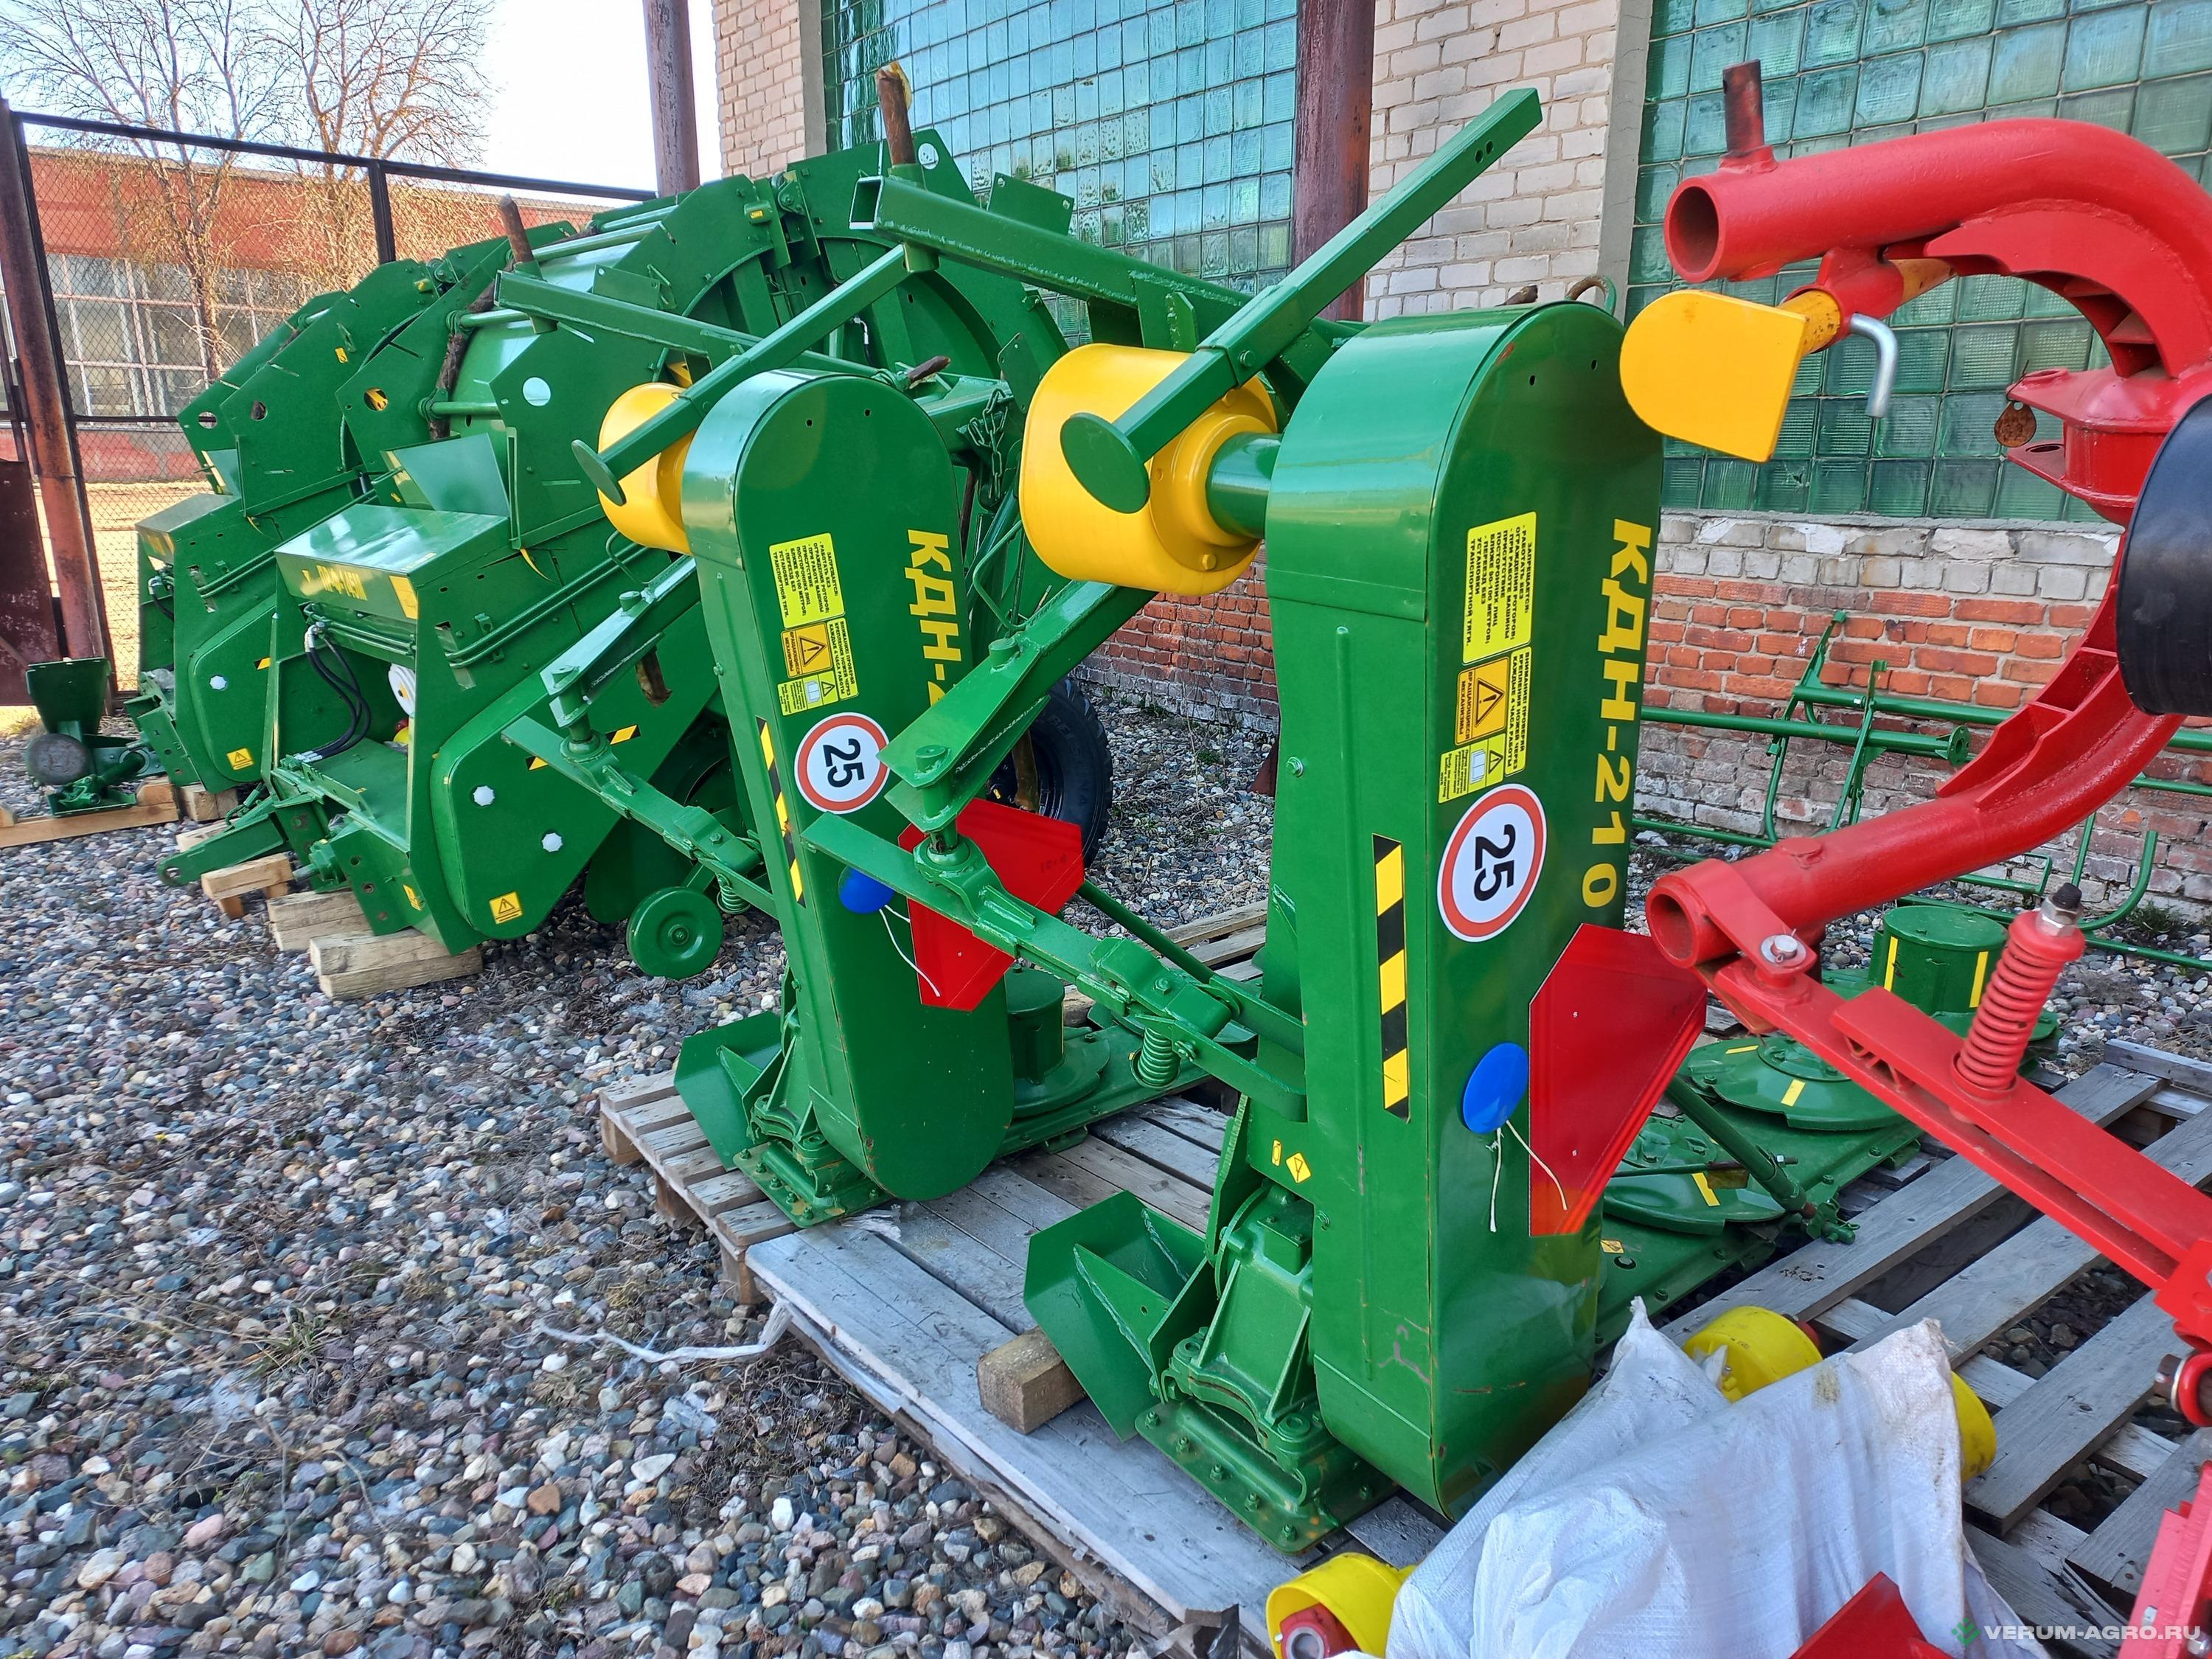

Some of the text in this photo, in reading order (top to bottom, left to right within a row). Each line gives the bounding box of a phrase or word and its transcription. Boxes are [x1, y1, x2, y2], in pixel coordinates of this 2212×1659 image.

[773, 552, 785, 599] ТРАНСПОРТНОЙ
[779, 551, 789, 586] УСТАНОВКИ
[785, 552, 793, 580] ПЕРЕЕЗД
[796, 547, 807, 591] ПОСТОРОННИХ
[802, 546, 813, 588] ПРИСУТСТВИЕ
[814, 543, 824, 583] ОГРАЖДЕНИЯ
[820, 545, 828, 575] РАБОТАТЬ
[827, 552, 838, 596] ЗАПРЕЩАЕТСЯ:
[1467, 538, 1475, 616] ТРАНСПОРТНОЙ
[810, 561, 818, 584] РАБОТЕ
[815, 585, 824, 613] МАШИНЫ
[785, 637, 793, 672] МЕХАНИЗМЫ
[790, 632, 800, 675] ВРАЩАЮЩИЕСЯ
[830, 624, 838, 649] КАЖДЫЕ
[835, 622, 844, 656] КРЕПЛЕНИЯ
[846, 655, 855, 684] ПРОВЕРЯЙ
[1582, 518, 1652, 908] КДН-210
[823, 738, 865, 788] 25
[1475, 824, 1516, 901] 25
